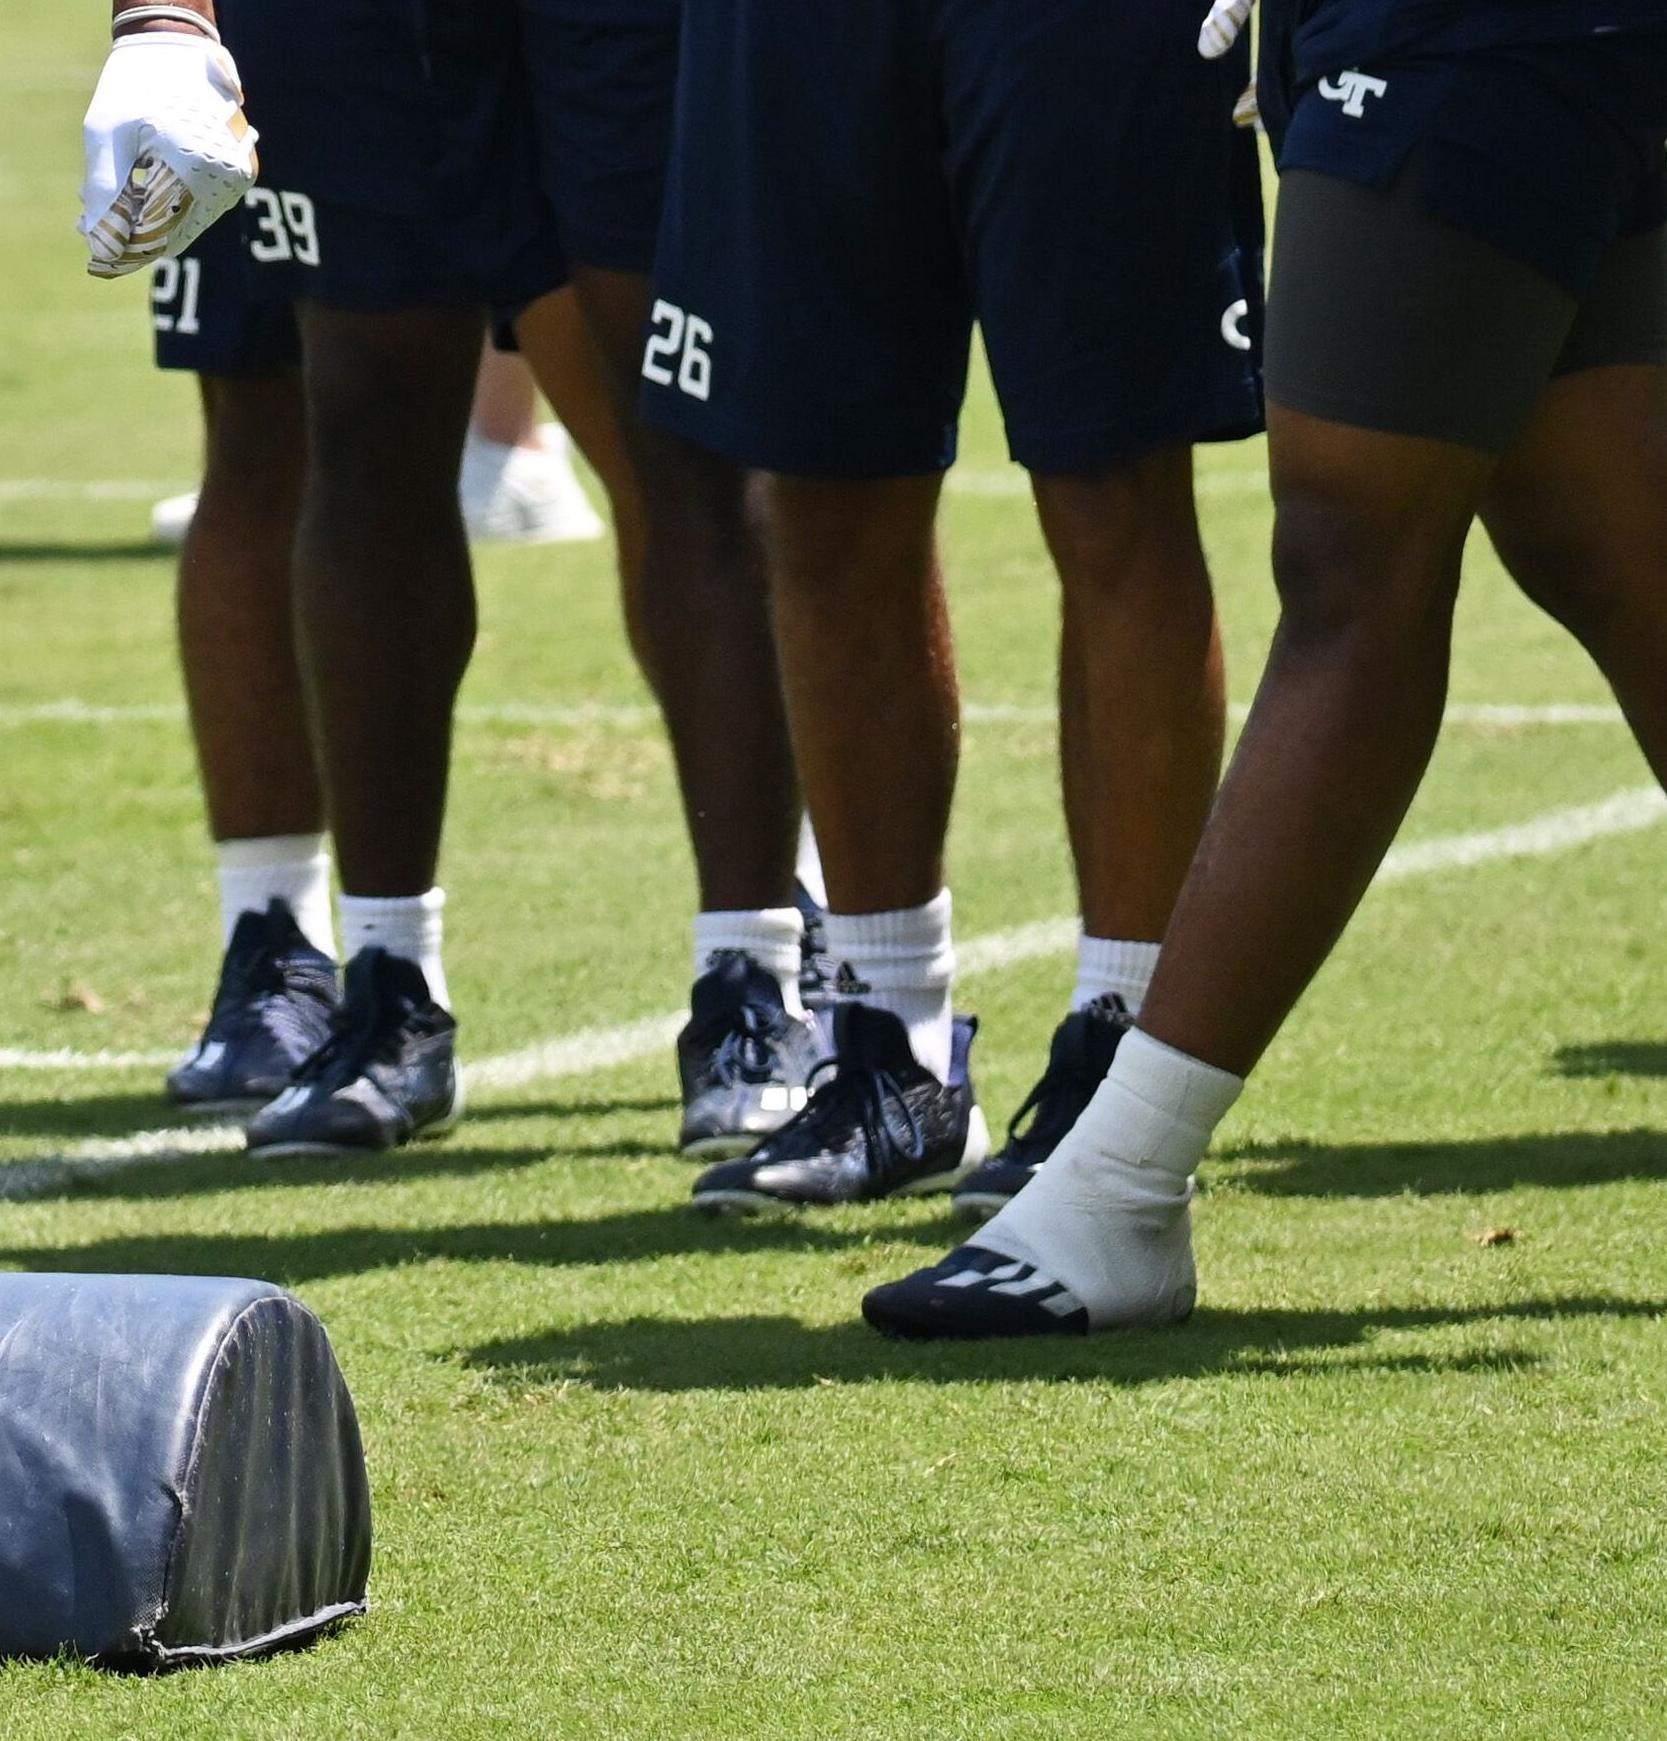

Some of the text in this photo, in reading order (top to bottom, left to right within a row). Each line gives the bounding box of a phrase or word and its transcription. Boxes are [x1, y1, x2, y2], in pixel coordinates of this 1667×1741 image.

[244, 187, 320, 266] 39
[153, 257, 201, 334] 21
[642, 298, 714, 402] 26
